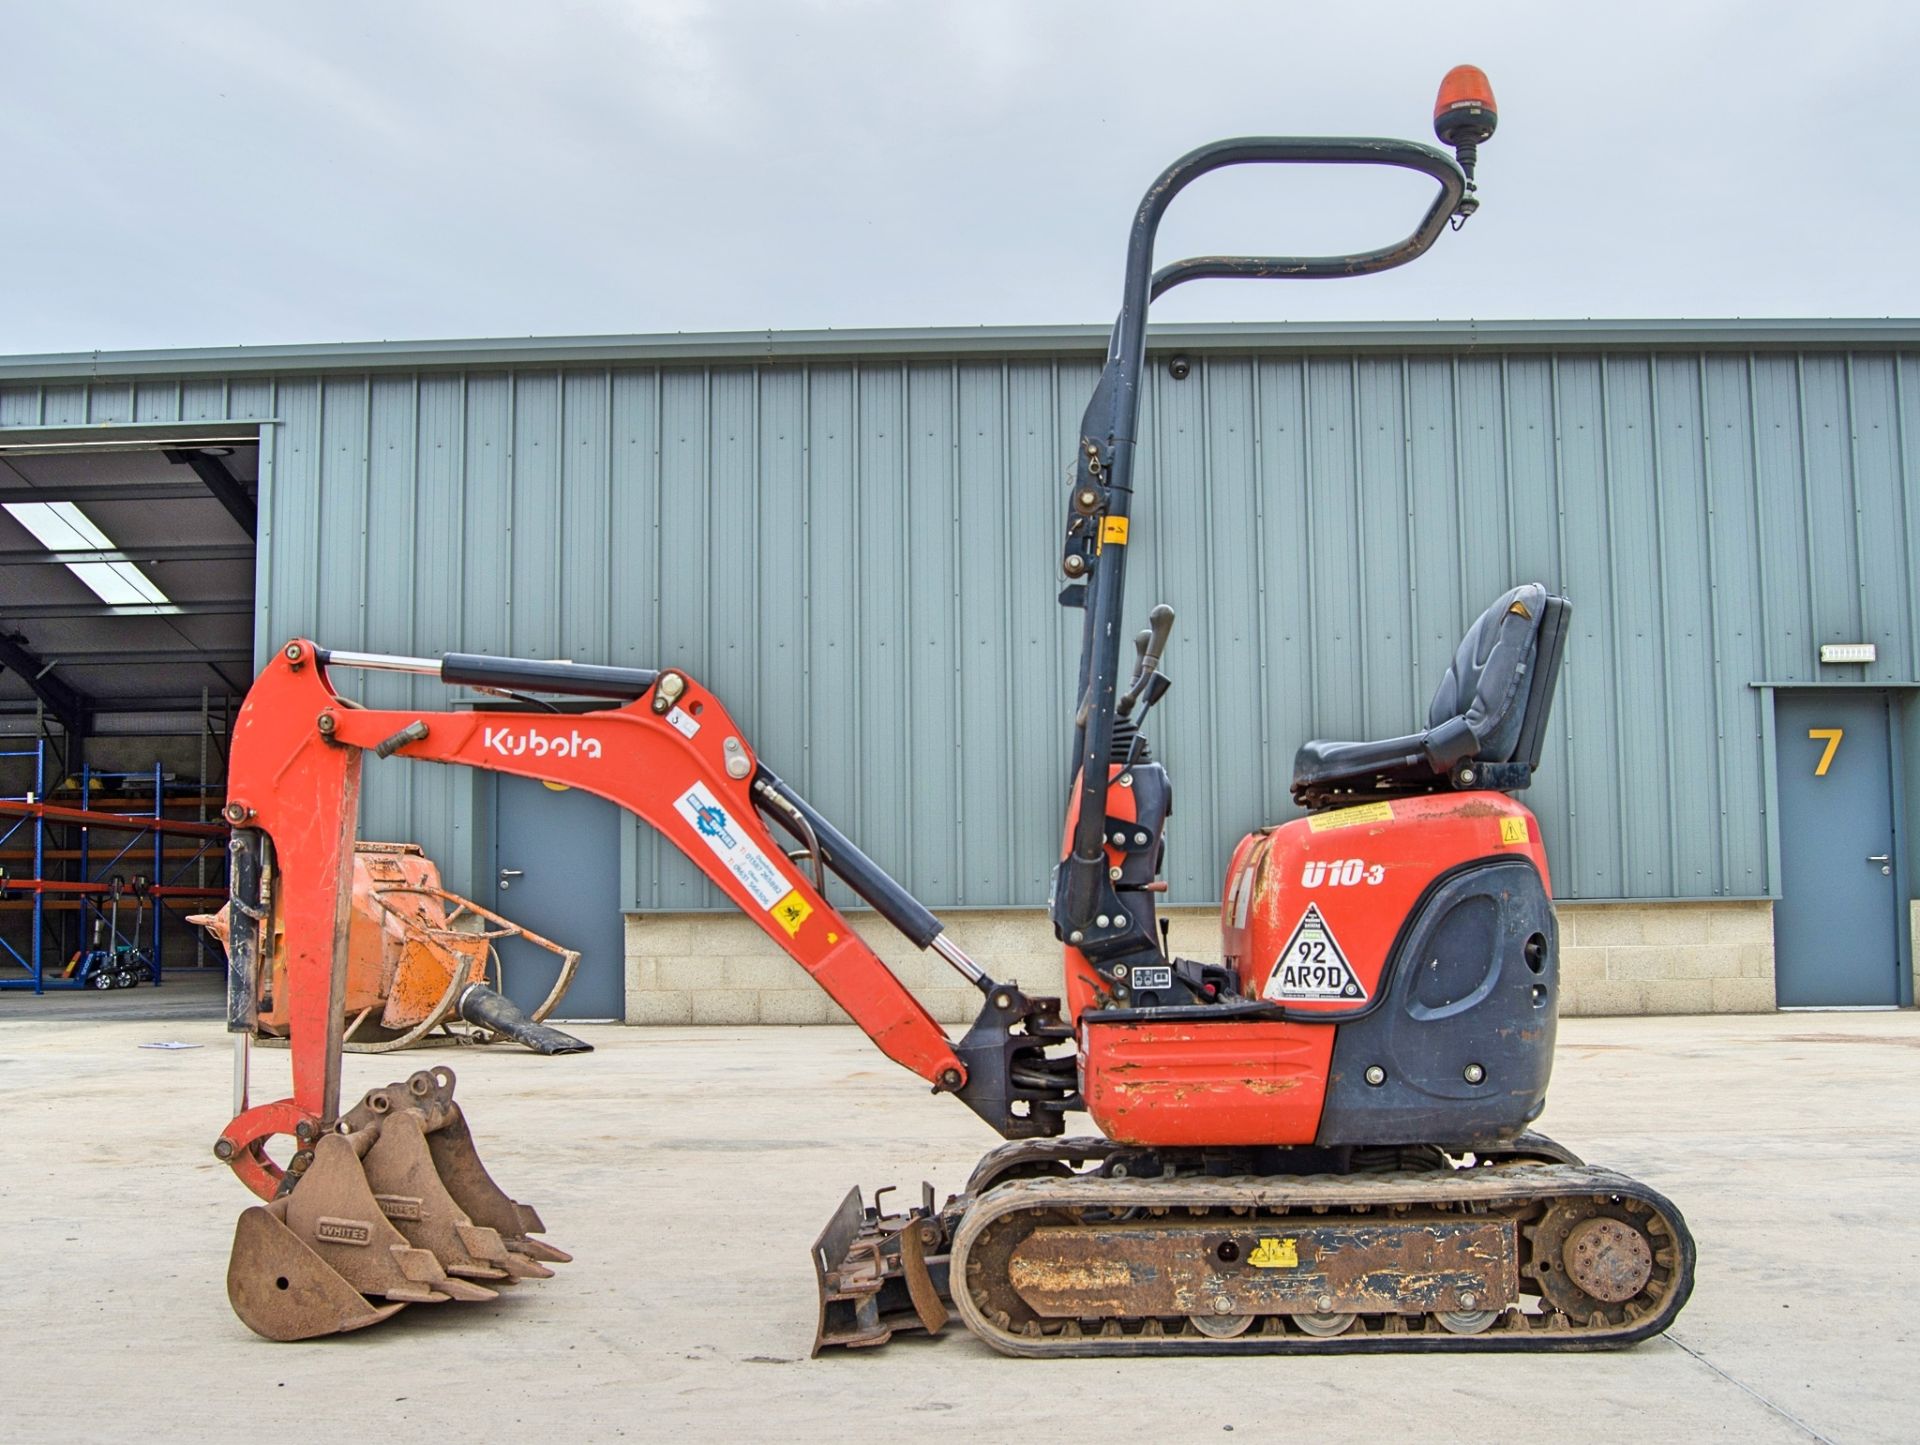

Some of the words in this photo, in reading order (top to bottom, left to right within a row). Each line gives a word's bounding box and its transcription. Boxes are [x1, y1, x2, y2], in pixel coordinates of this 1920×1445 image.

[484, 727, 602, 758] Kubota
[1808, 729, 1843, 776] 7
[1301, 859, 1384, 887] U10-3
[1298, 942, 1326, 964] 92
[1283, 966, 1341, 988] AR9D
[321, 1225, 366, 1239] WHITES
